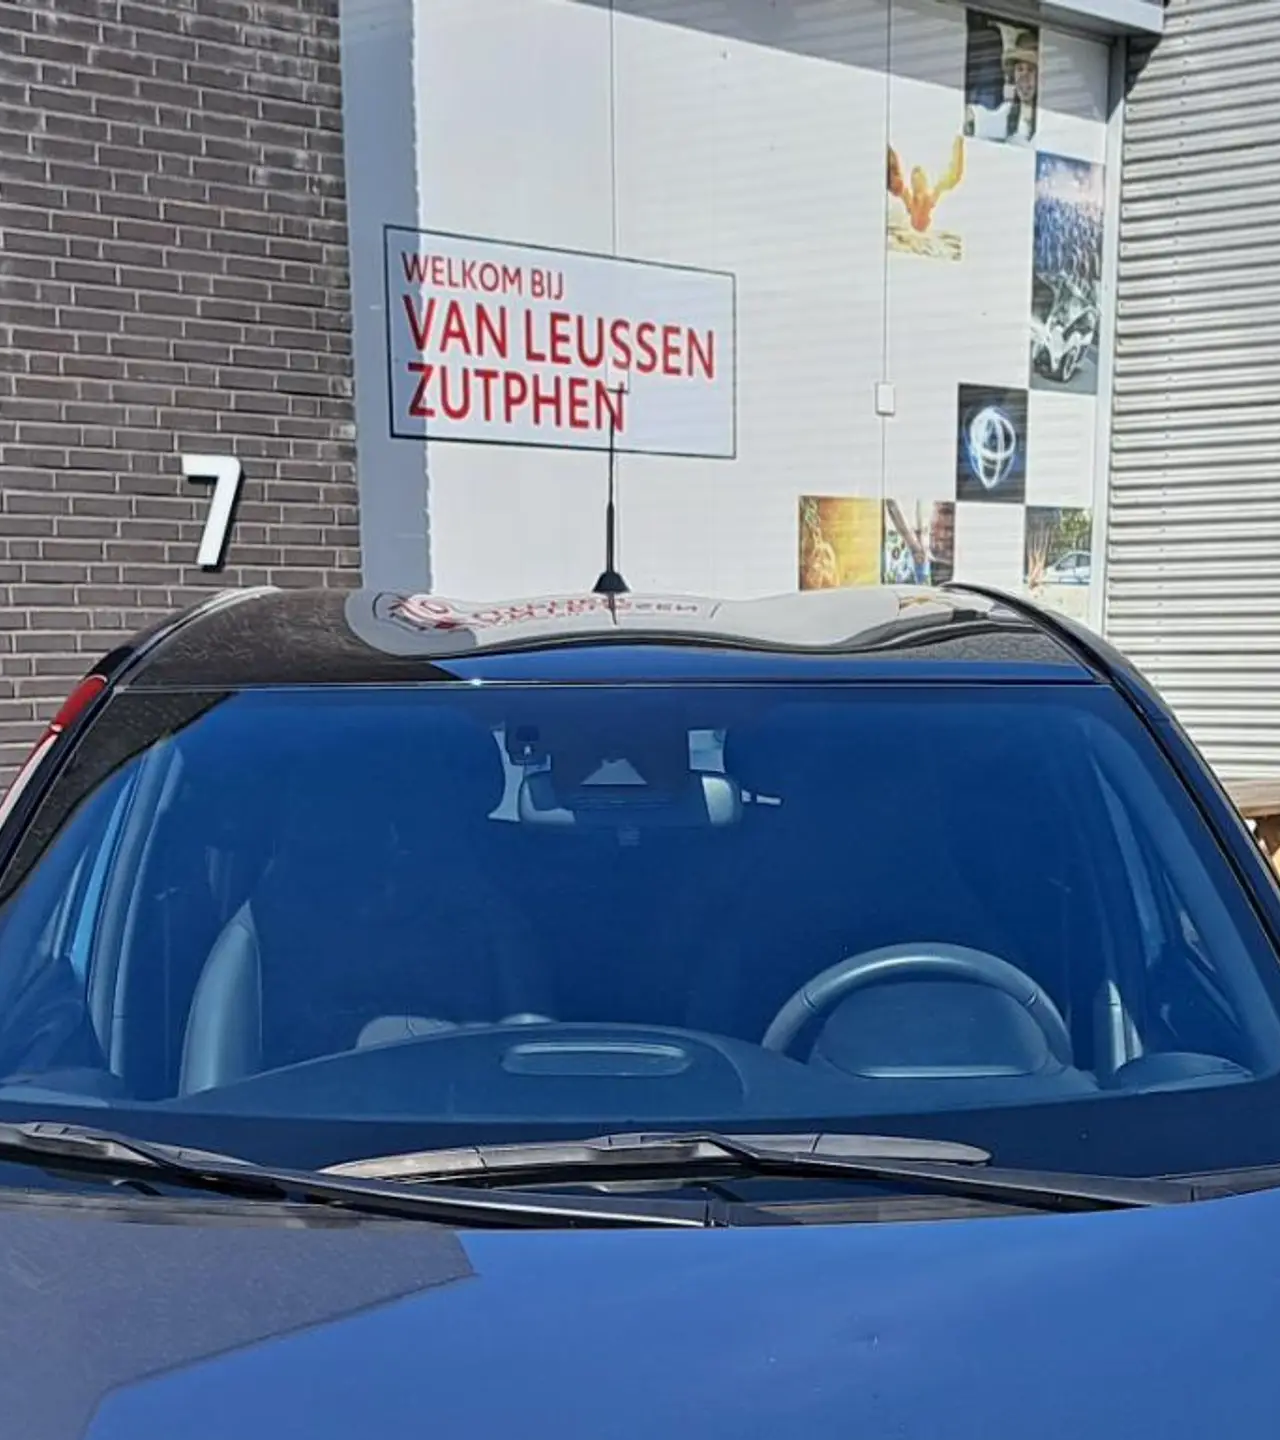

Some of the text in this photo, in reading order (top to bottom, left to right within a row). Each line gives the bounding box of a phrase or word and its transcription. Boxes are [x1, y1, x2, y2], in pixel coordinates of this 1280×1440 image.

[401, 251, 564, 300] WELKOM BIJ
[402, 294, 715, 379] VAN LEUSSEN
[407, 361, 624, 431] ZUTPHEN
[182, 455, 241, 566] 7
